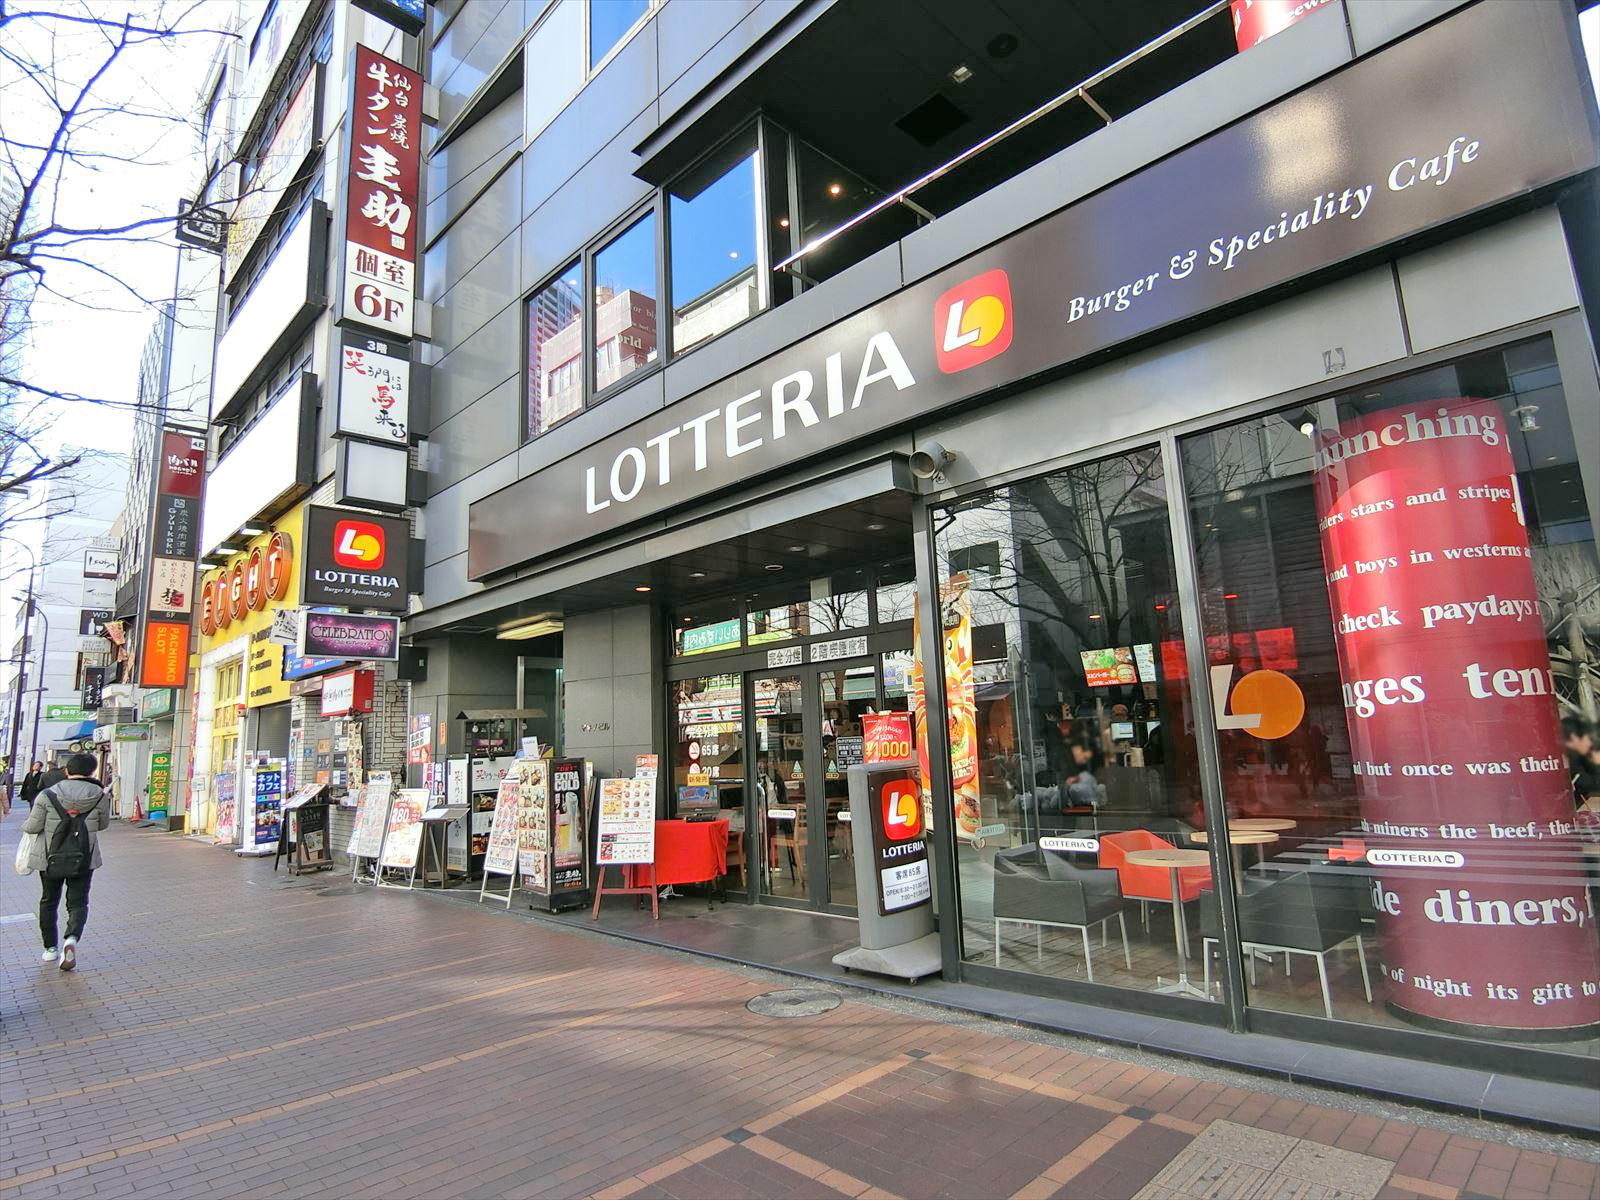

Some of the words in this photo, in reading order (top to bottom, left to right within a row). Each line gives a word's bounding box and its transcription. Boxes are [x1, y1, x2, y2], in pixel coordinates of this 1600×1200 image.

[393, 73, 412, 108] 仙台
[390, 114, 410, 150] 炭焼
[356, 143, 412, 235] 圭助
[1067, 272, 1159, 324] Burger
[1169, 250, 1198, 280] &
[1208, 185, 1372, 270] Speciality
[1388, 137, 1480, 193] Cafe
[355, 248, 406, 287] 個室
[353, 282, 404, 324] 6F
[367, 340, 388, 354] 3階
[585, 331, 916, 515] LOTTERIA
[1350, 498, 1395, 519] stars
[1406, 487, 1447, 506] and
[1458, 485, 1511, 502] stripes
[1330, 564, 1348, 582] and
[1355, 556, 1398, 574] boys
[1410, 549, 1434, 564] in
[1443, 543, 1521, 560] westerns
[314, 569, 400, 588] LOTTERIA
[323, 586, 343, 594] Burger
[351, 589, 378, 598] Speciality
[1338, 606, 1402, 635] check
[1421, 594, 1532, 629] paydays
[156, 626, 168, 655] SLOT
[311, 625, 393, 642] CELEBRATION
[166, 627, 180, 682] PACHINKO
[701, 744, 720, 756] 65席
[257, 773, 280, 783] ネット
[554, 771, 579, 781] EXTRA
[1366, 762, 1392, 776] but
[1401, 763, 1453, 777] once
[1465, 760, 1511, 775] was
[1520, 755, 1559, 772] their
[151, 769, 168, 808] 処方せん受付
[257, 782, 280, 791] カフェ
[554, 780, 580, 792] COLD
[1043, 839, 1086, 849] LOTTERIA
[1373, 821, 1429, 838] miners
[1439, 824, 1478, 839] the
[1489, 821, 1543, 840] beef,
[1549, 820, 1572, 836] the
[882, 841, 925, 858] LOTTERIA
[1374, 853, 1443, 864] LOTTERIA
[1424, 889, 1585, 927] diners,
[1391, 967, 1405, 983] of
[1413, 975, 1472, 997] night
[1486, 982, 1519, 1000] its
[1533, 982, 1574, 1005] gift
[1582, 981, 1596, 996] to
